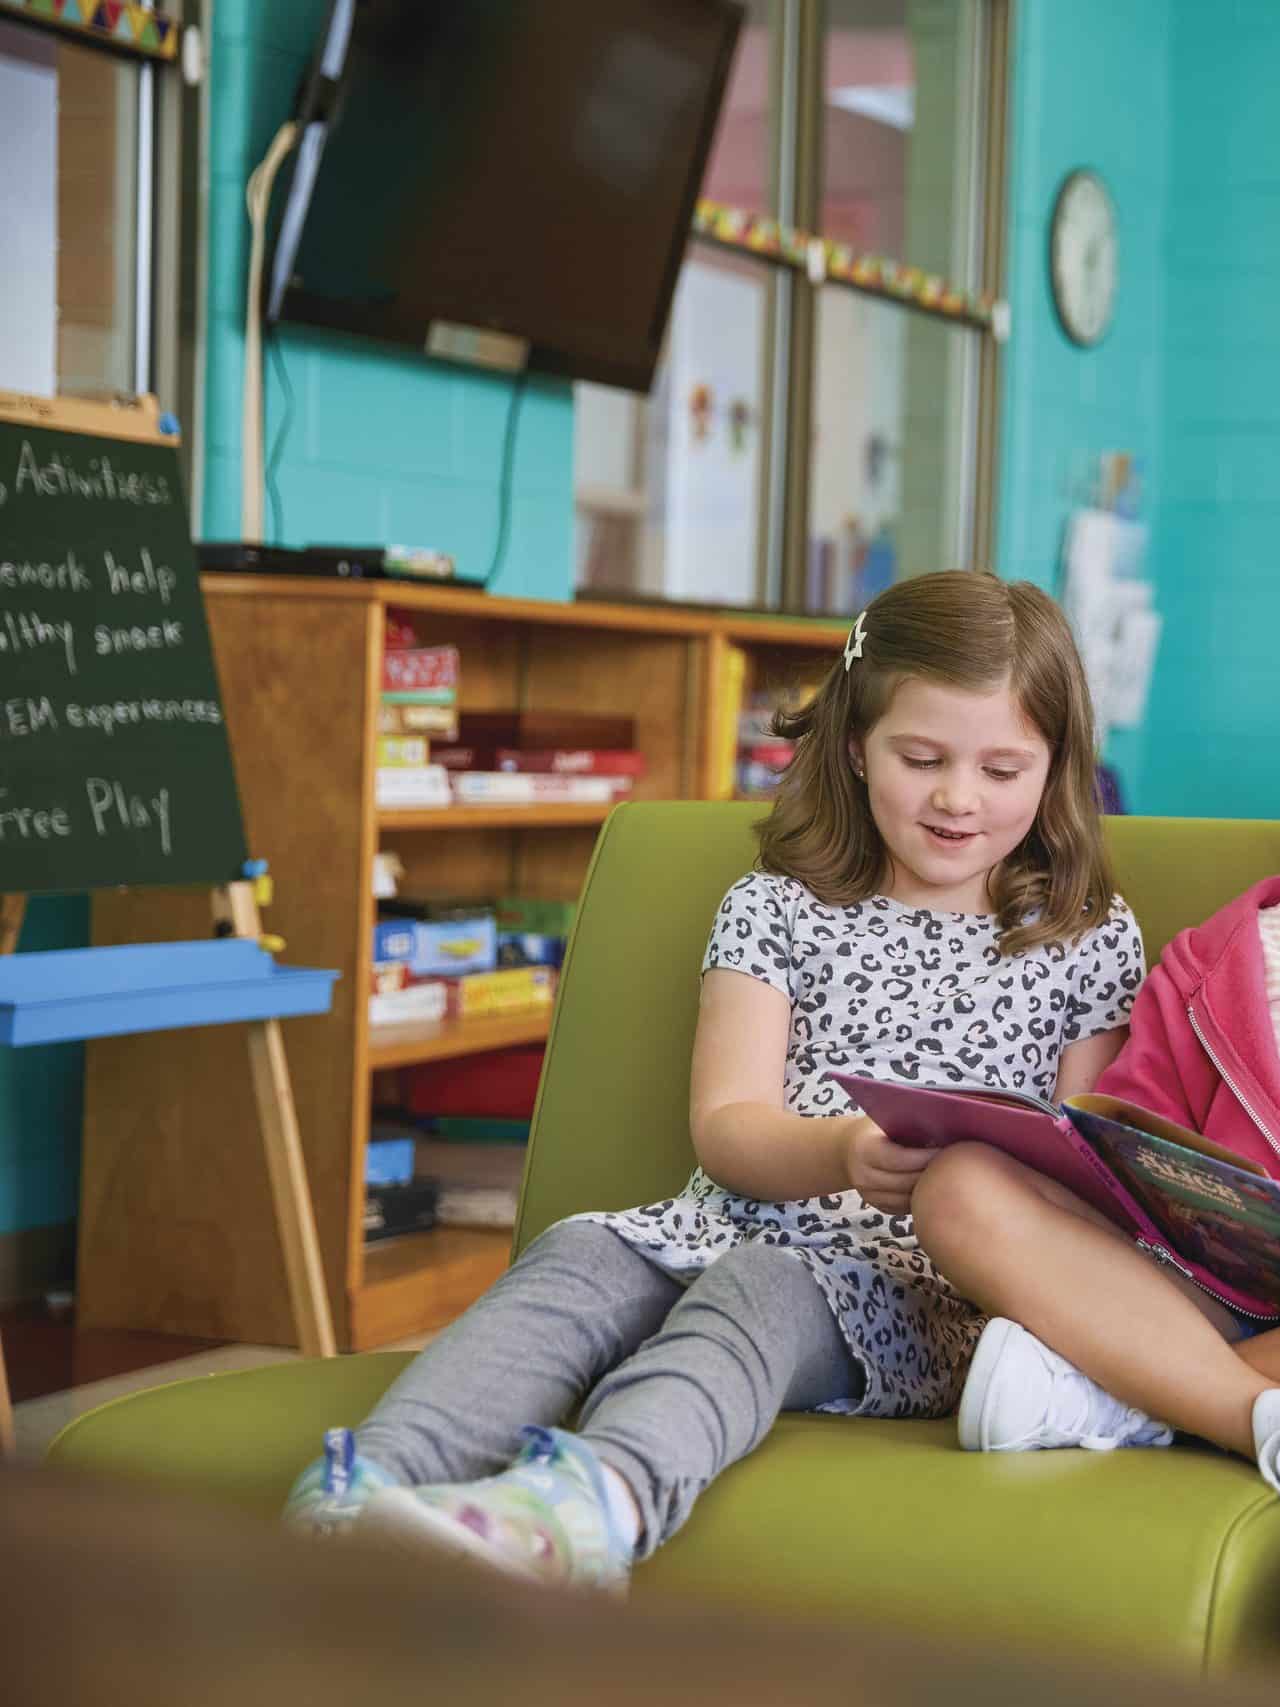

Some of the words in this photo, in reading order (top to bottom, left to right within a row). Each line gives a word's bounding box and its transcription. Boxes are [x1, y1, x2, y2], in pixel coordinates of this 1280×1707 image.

[15, 439, 173, 504] Activities
[103, 546, 177, 605] help
[65, 699, 223, 738] experiences
[86, 776, 173, 856] Play
